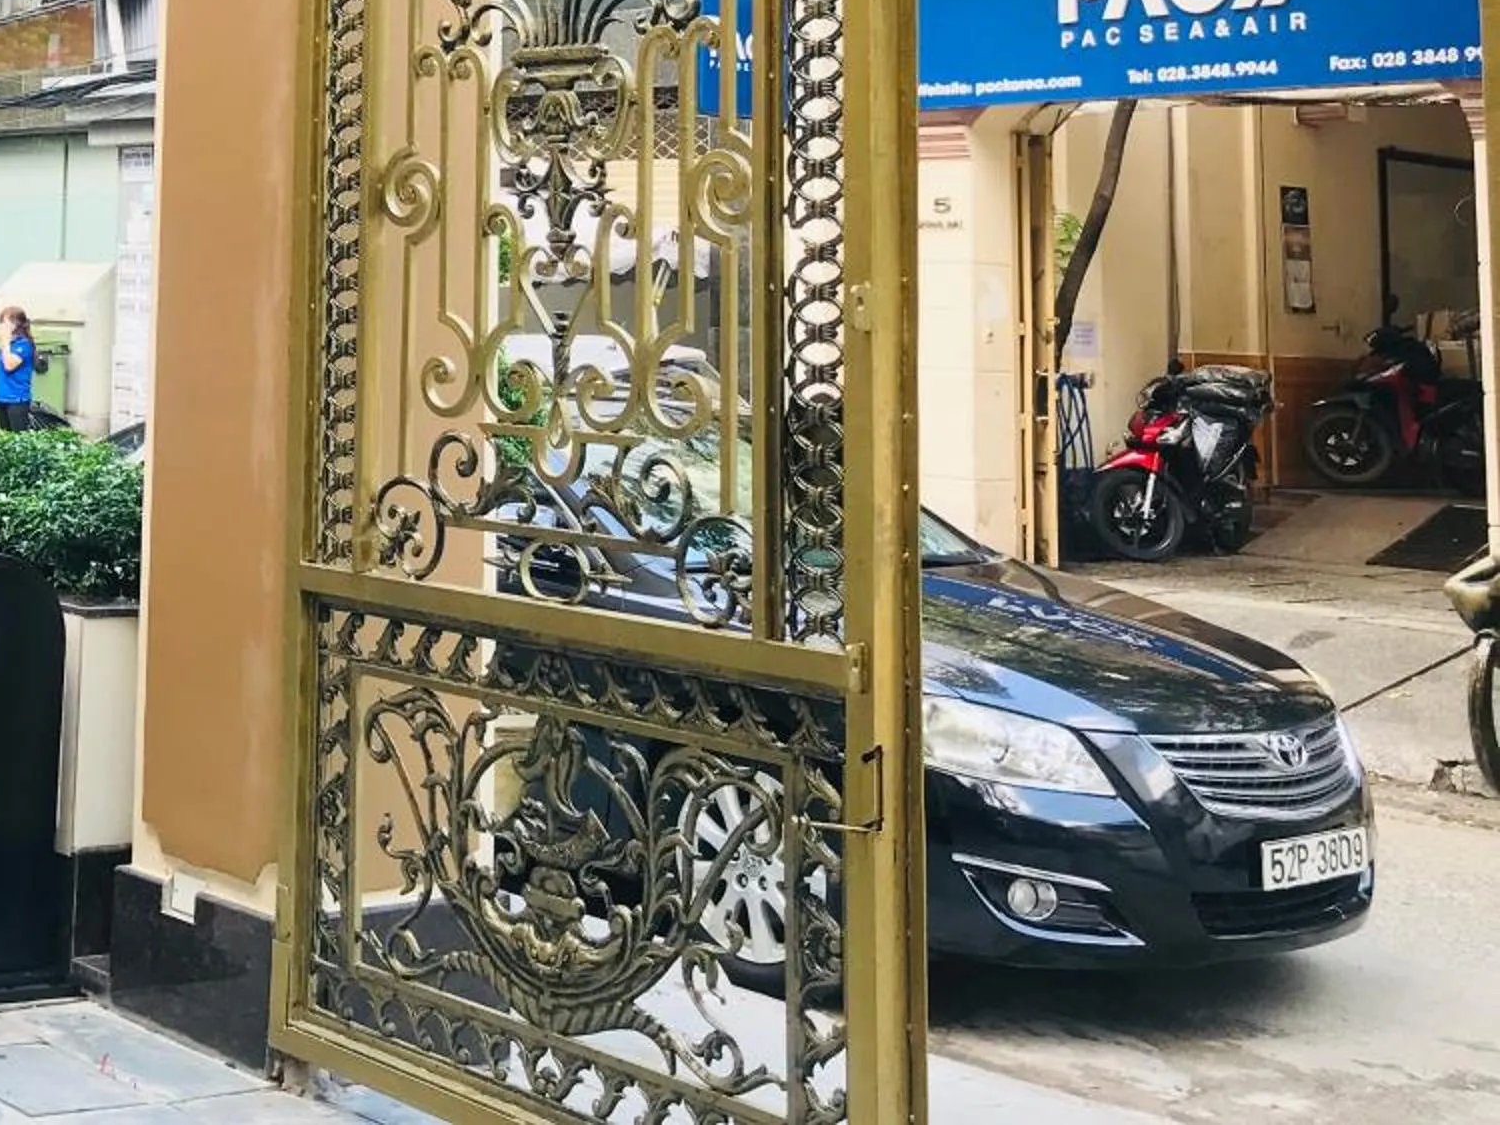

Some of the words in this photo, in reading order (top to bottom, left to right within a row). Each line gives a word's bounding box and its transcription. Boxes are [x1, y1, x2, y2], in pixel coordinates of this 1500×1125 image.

[1061, 27, 1121, 49] PAC
[1329, 55, 1367, 71] Fax:
[1371, 51, 1407, 68] 028
[1412, 47, 1459, 66] 3848
